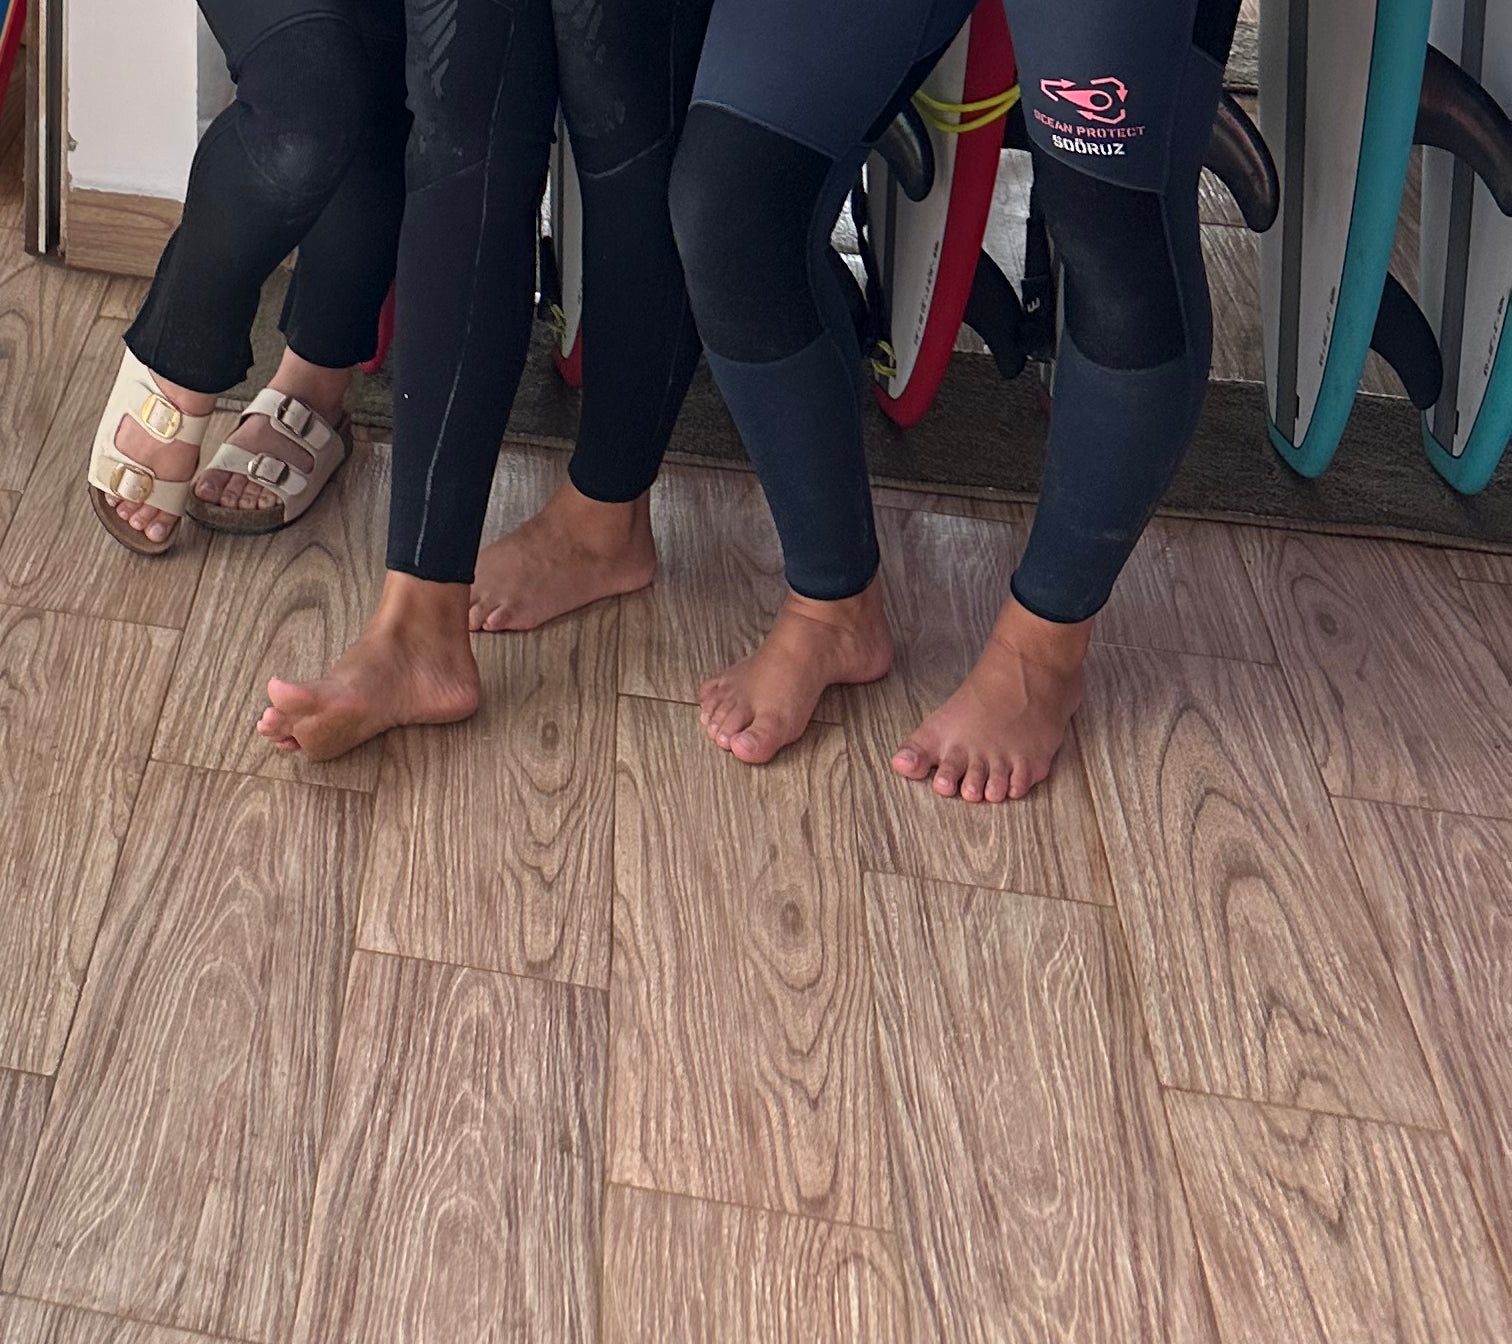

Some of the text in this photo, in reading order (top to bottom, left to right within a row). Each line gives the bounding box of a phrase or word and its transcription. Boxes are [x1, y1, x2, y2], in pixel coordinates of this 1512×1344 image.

[1033, 109, 1145, 139] OCEAN PROTECT
[1052, 134, 1125, 156] SOÖRUZ
